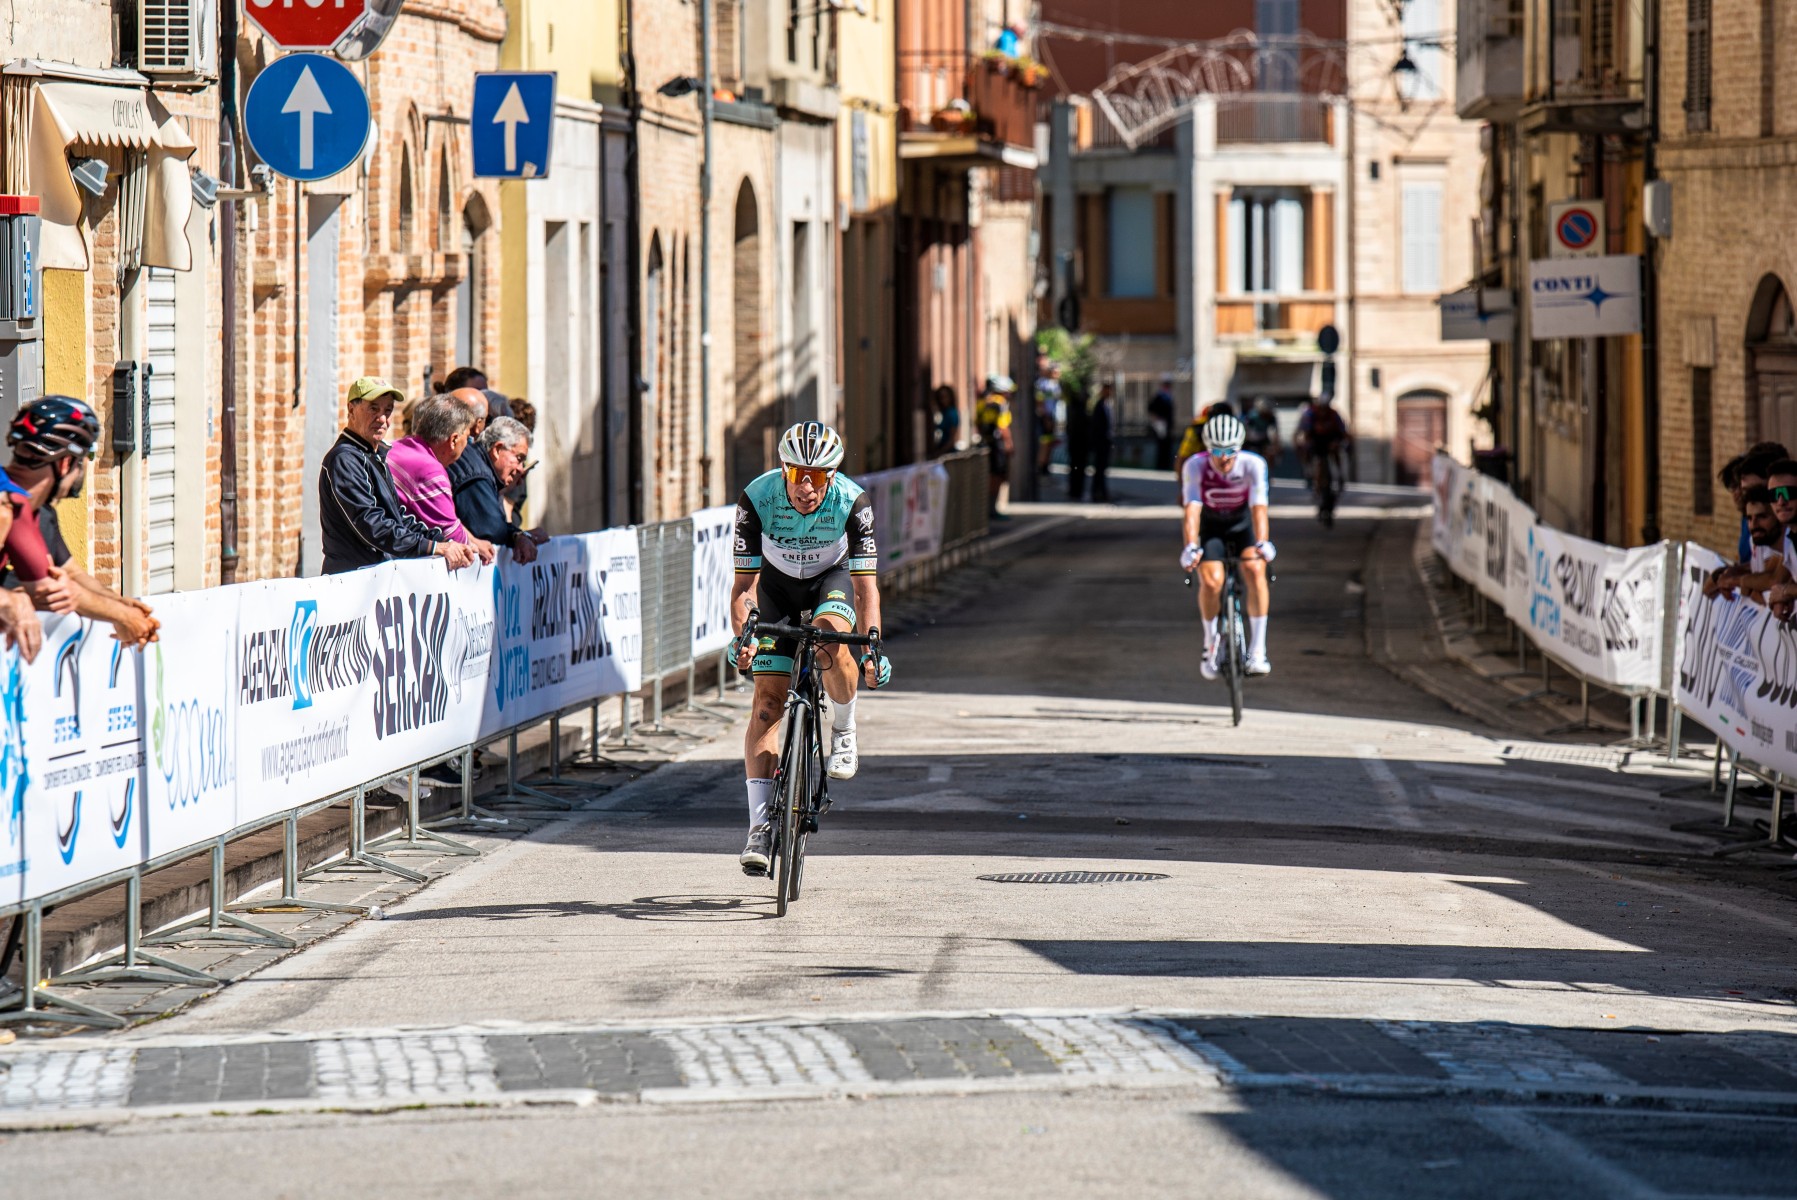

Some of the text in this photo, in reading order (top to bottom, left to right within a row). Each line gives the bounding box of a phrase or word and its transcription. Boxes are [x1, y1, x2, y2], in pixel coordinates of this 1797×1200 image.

[1532, 276, 1593, 292] CONTI
[782, 553, 820, 561] ENERGY
[240, 628, 293, 706] AGENZIA
